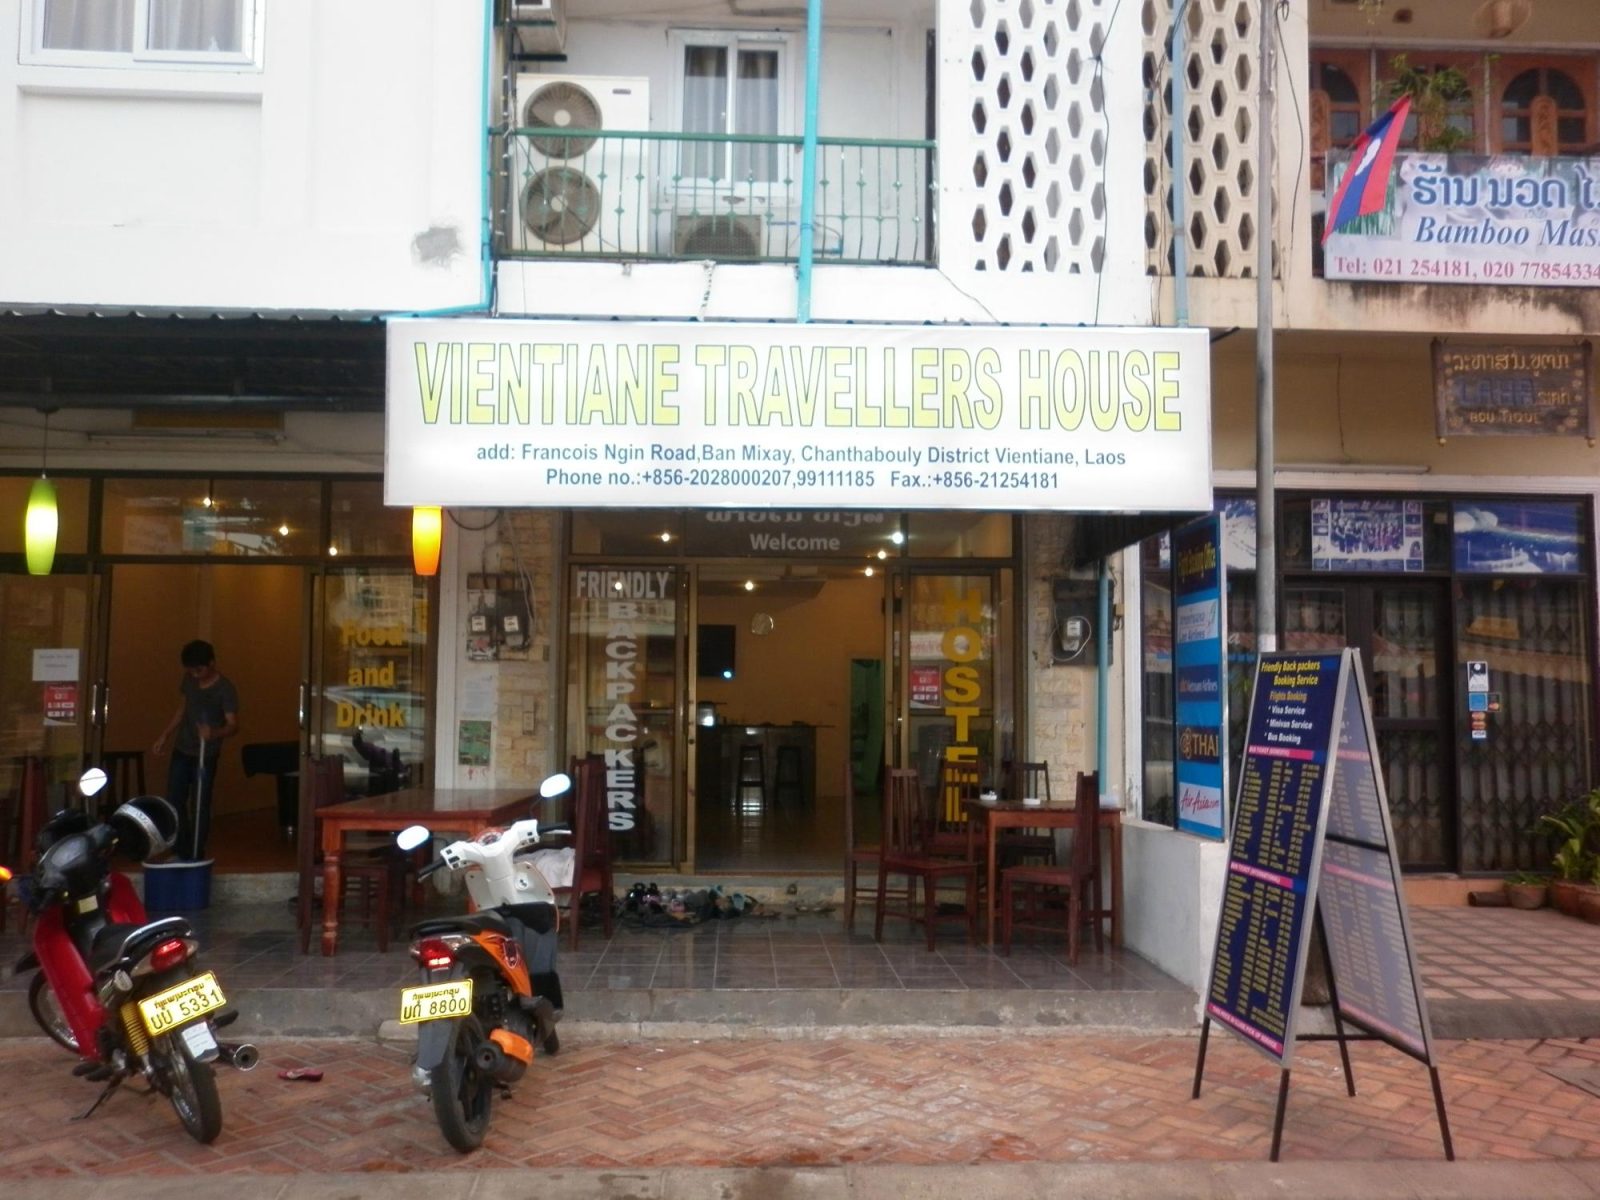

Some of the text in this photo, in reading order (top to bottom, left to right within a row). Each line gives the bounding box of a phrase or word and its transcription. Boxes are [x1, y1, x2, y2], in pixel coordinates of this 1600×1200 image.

[1415, 216, 1600, 247] Bamboo Mas
[1334, 258, 1367, 275] Tel:
[1374, 259, 1401, 275] 021
[1410, 260, 1477, 280] 254181,
[1483, 262, 1514, 278] 020
[414, 342, 1182, 432] VIENTIANE TRAVELLERS HOUSE
[477, 445, 514, 460] add:
[522, 445, 598, 460] Francois
[604, 445, 644, 465] Ngin
[742, 446, 796, 465] Mixay,
[801, 445, 922, 466] Chanthabouly
[928, 447, 990, 464] District
[995, 447, 1079, 467] Vientiane,
[1085, 449, 1126, 465] Laos
[546, 468, 602, 485] Phone
[750, 533, 840, 551] Welcome
[576, 571, 670, 599] FRIENDLY
[348, 660, 396, 687] and
[1297, 674, 1318, 685] Service
[336, 702, 407, 728] Drink
[604, 601, 638, 831] BACKPACKERS
[941, 588, 981, 822] HOSTEL
[1285, 706, 1305, 715] Service
[1269, 719, 1312, 730] Minivan Service
[1192, 734, 1219, 757] THAI
[1278, 733, 1301, 745] Booking
[179, 989, 220, 1016] 5331
[429, 998, 467, 1015] 8800
